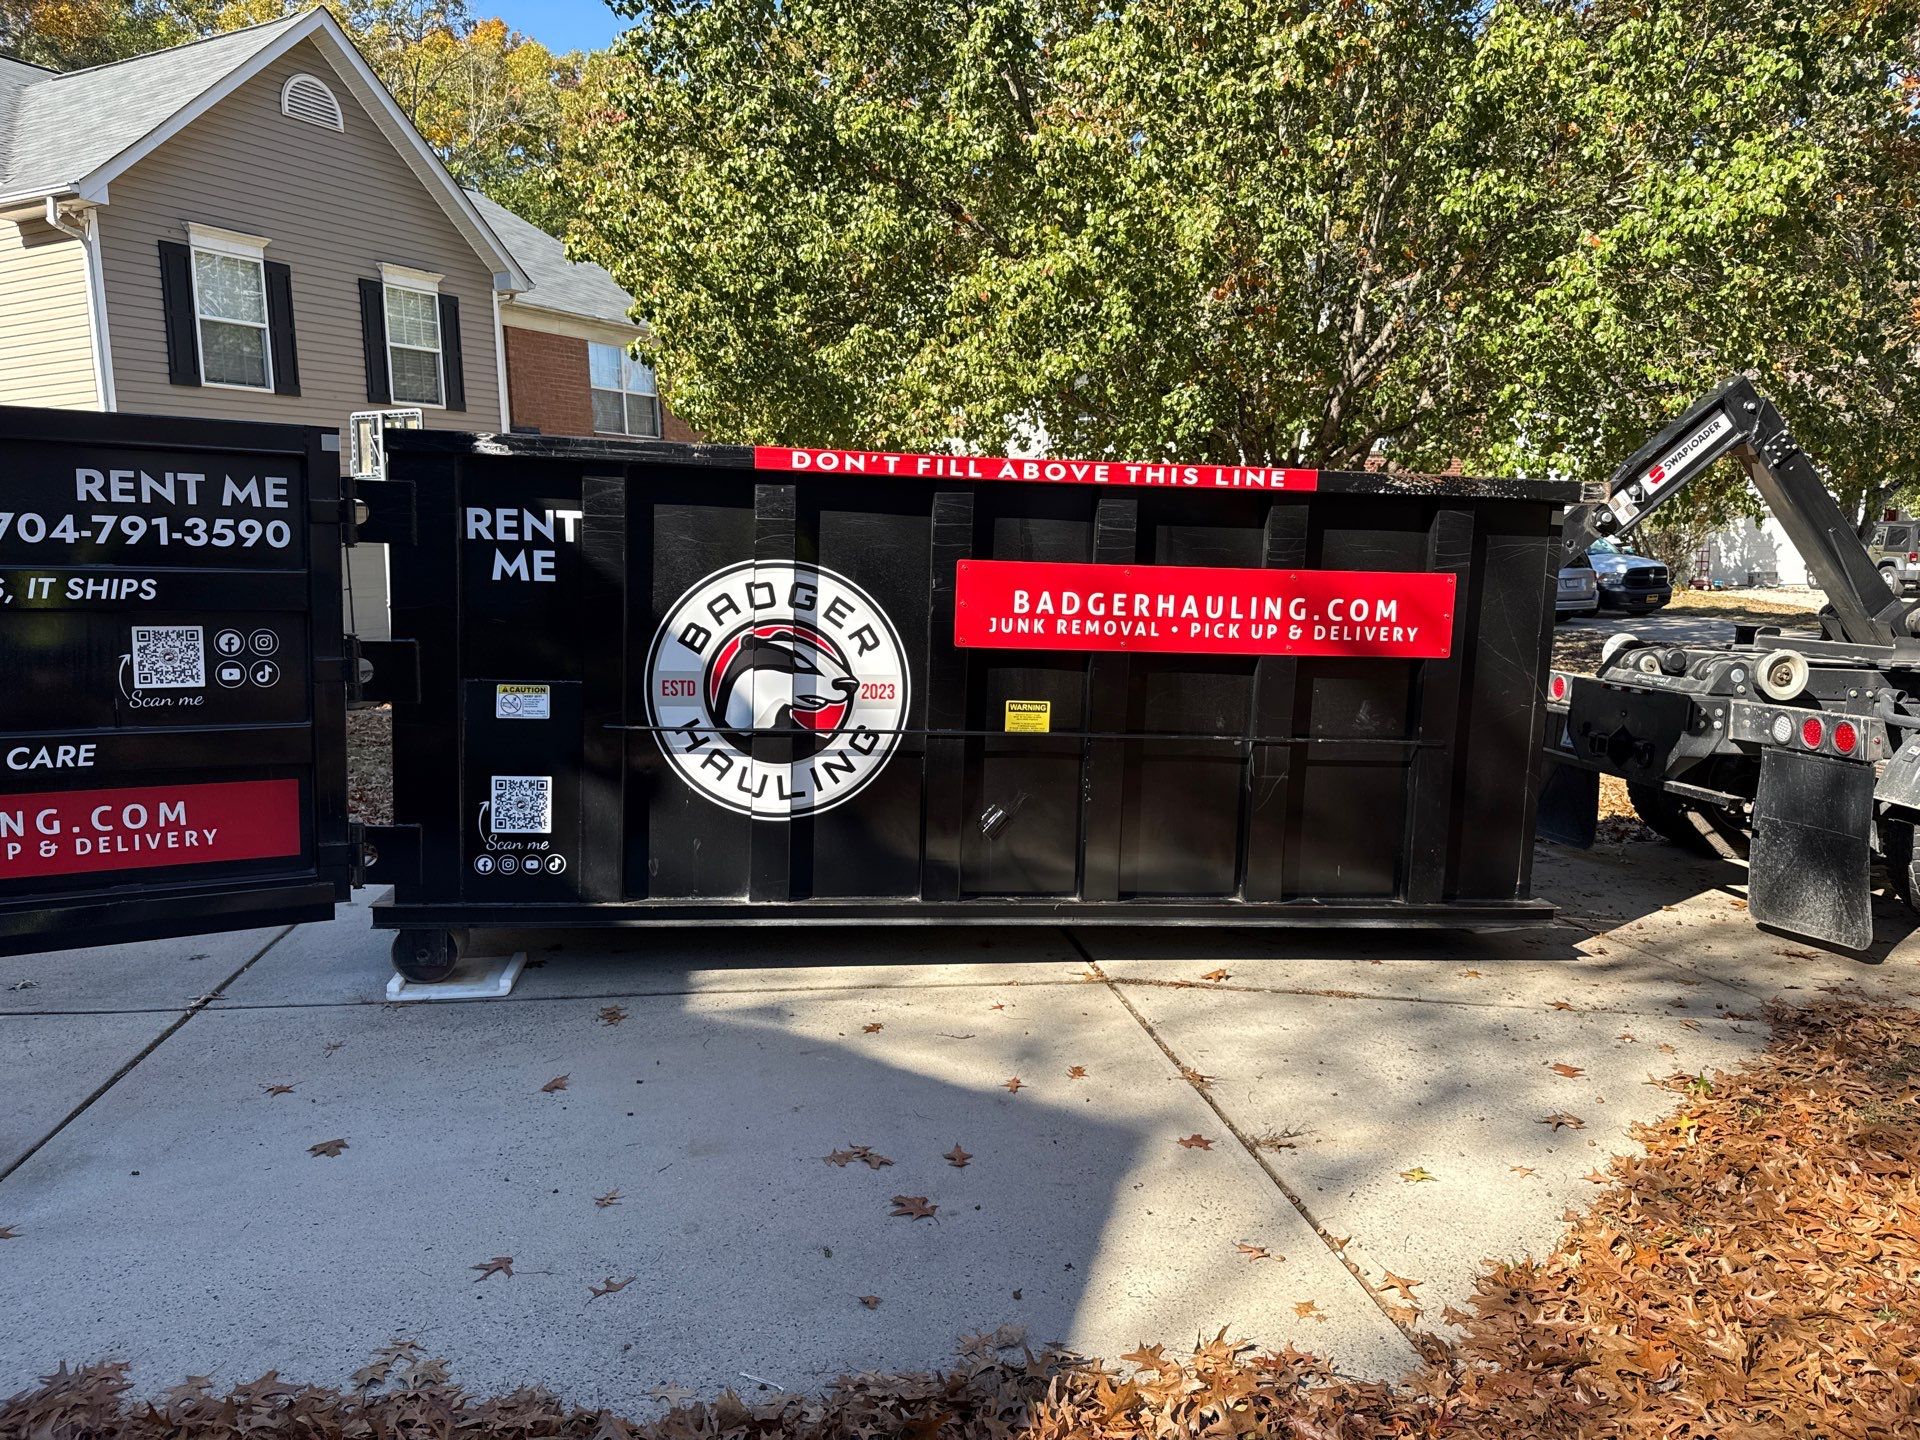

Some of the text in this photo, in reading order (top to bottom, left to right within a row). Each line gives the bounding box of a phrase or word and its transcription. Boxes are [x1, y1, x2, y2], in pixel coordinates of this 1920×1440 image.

[1664, 421, 1722, 471] SWAPLOADER
[791, 451, 1286, 488] DON'T FILL ABOVE THIS LINE
[76, 468, 289, 509] RENT ME
[0, 512, 291, 548] 704-791-3590
[466, 507, 583, 543] RENT
[491, 547, 556, 582] ME
[27, 577, 57, 599] IT
[65, 577, 157, 600] SHIPS
[677, 581, 881, 657] BADGER
[1013, 590, 1398, 623] BADGERHAULING.COM
[989, 617, 1045, 634] JUNK
[1056, 619, 1160, 637] REMOVAL
[1190, 622, 1240, 639] PICK
[1250, 623, 1278, 640] UP
[1288, 624, 1303, 640] &
[1313, 625, 1419, 642] DELIVERY
[129, 690, 205, 709] Scan me
[509, 686, 547, 694] CAUTION
[661, 679, 896, 700] ESTD 2023
[1009, 703, 1047, 712] WARNING
[6, 744, 97, 770] CARE
[673, 718, 881, 801] HAULING
[39, 840, 59, 858] &
[75, 829, 218, 856] DELIVERY
[486, 834, 550, 850] Scan me
